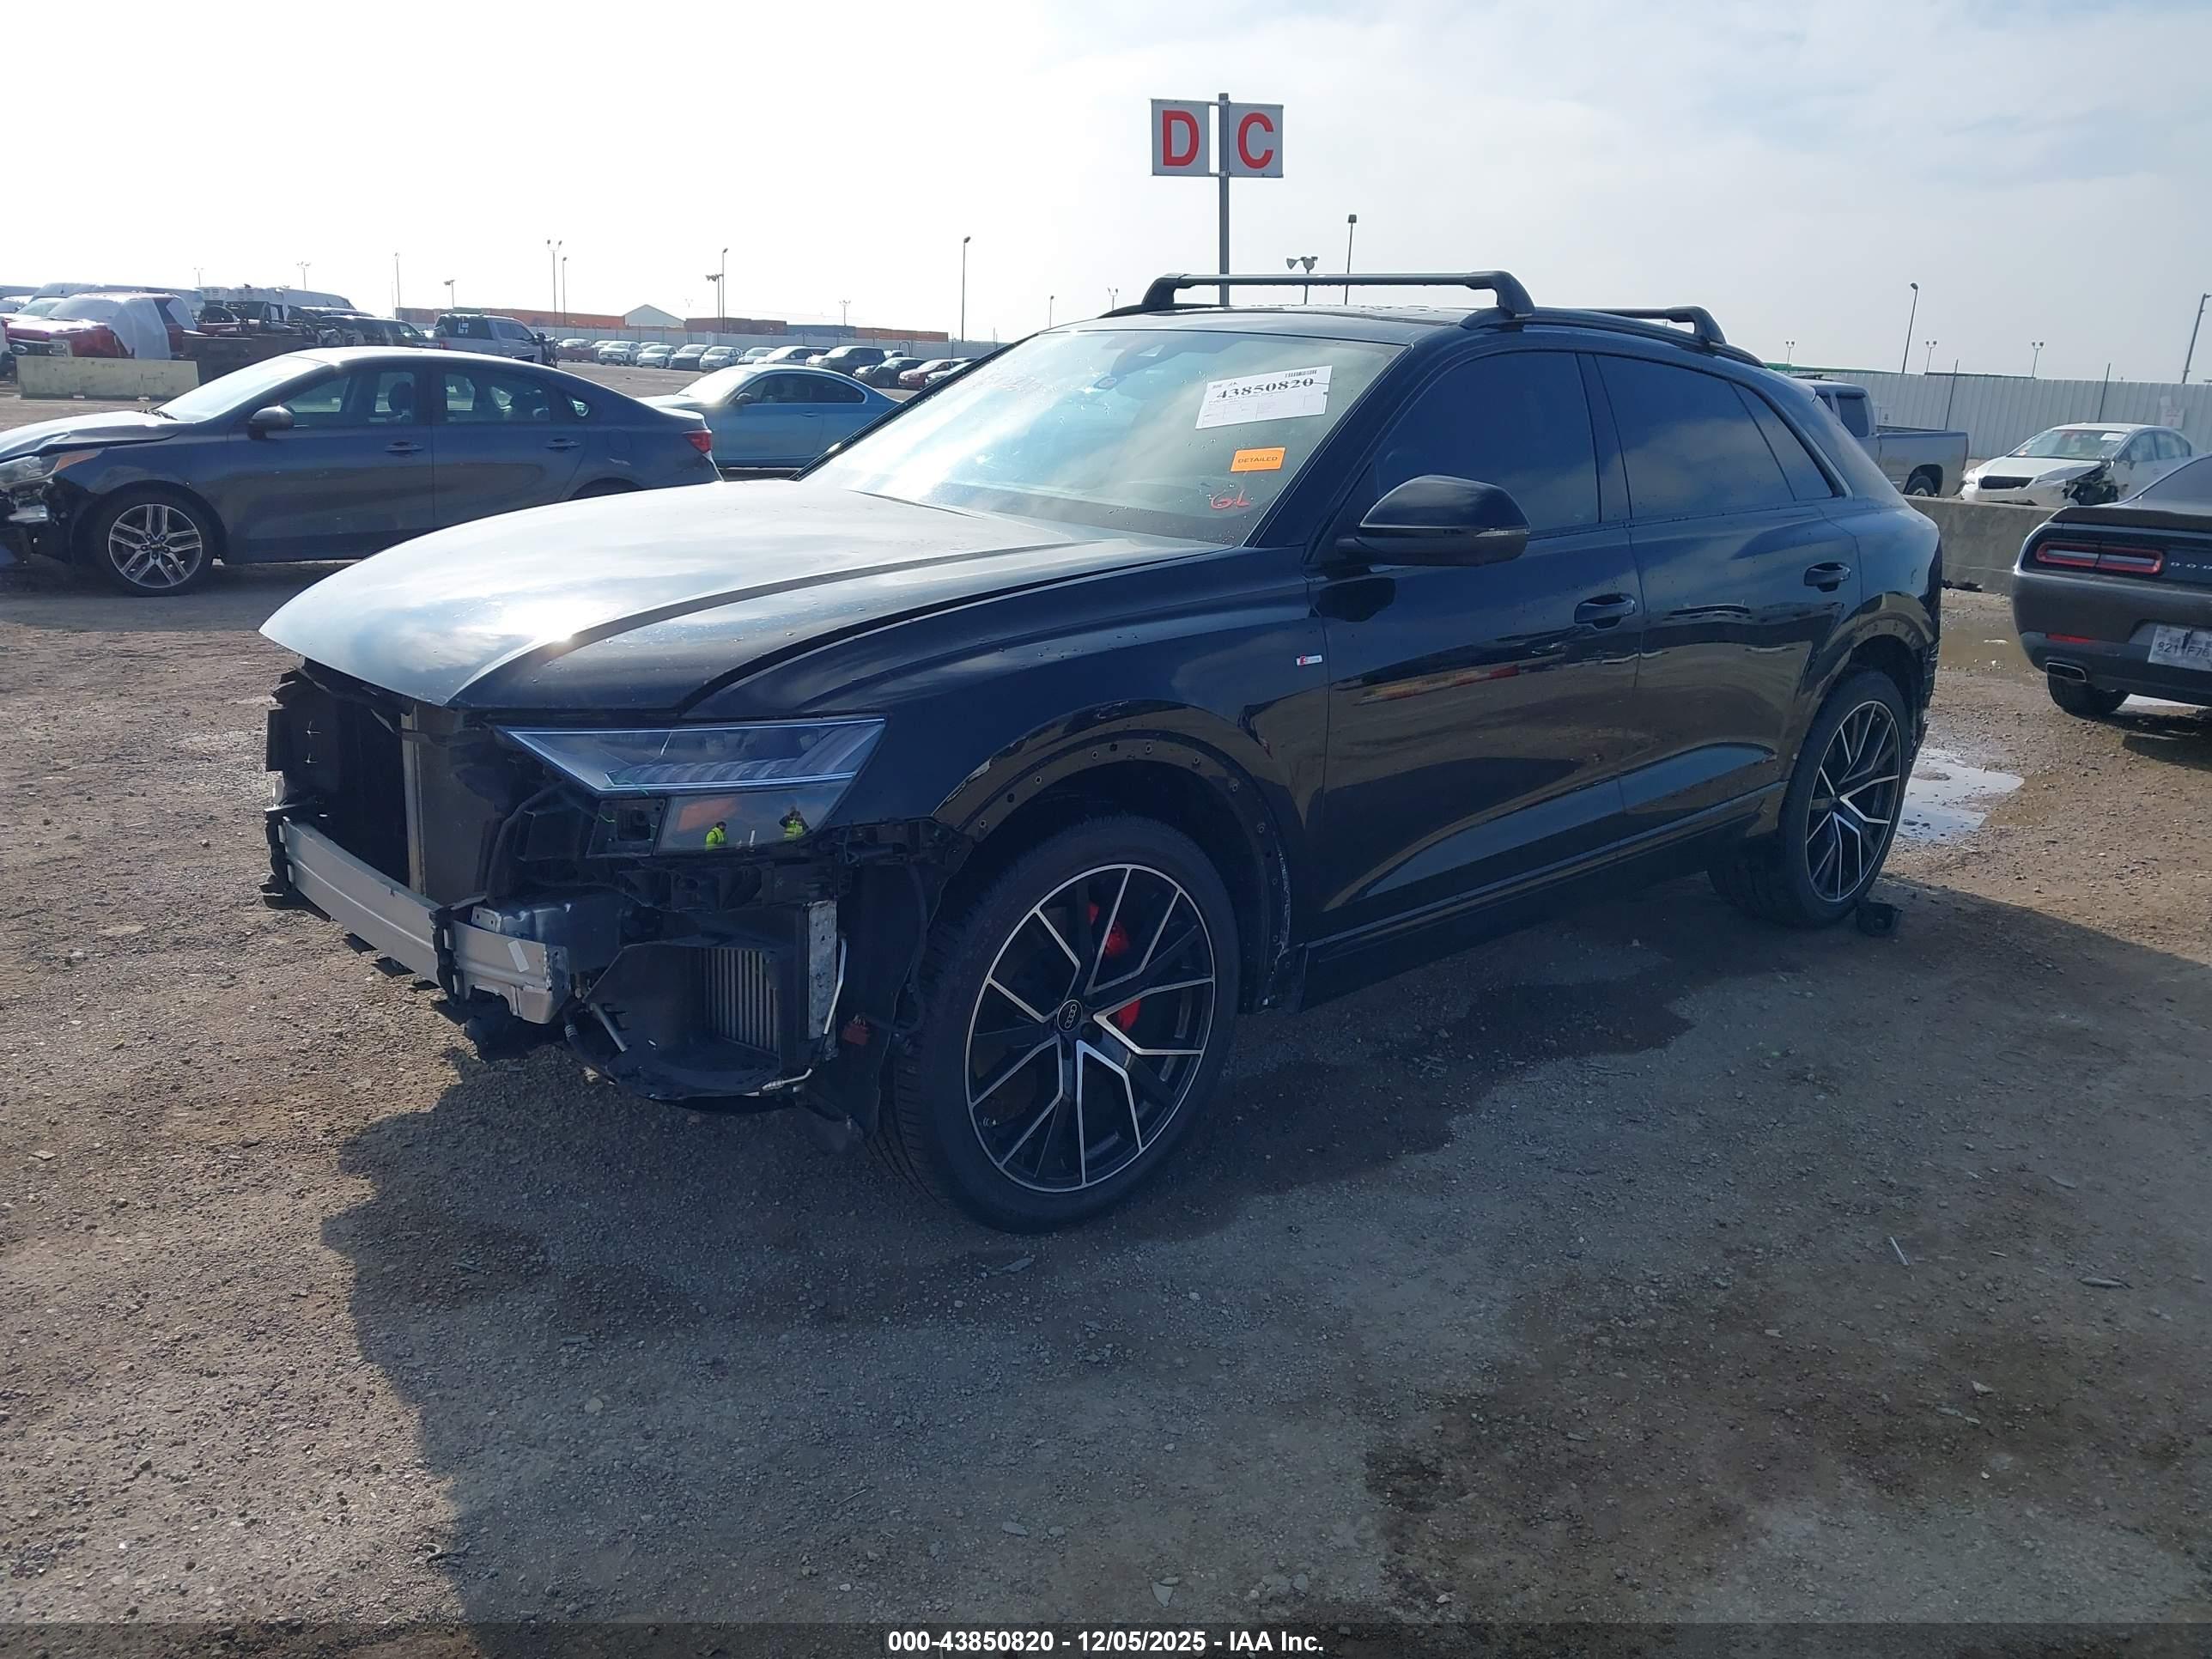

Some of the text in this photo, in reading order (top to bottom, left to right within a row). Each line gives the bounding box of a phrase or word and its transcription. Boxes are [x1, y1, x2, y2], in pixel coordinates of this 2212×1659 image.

[1162, 109, 1200, 167] D
[1237, 112, 1274, 169] C
[1216, 378, 1314, 398] 43850820
